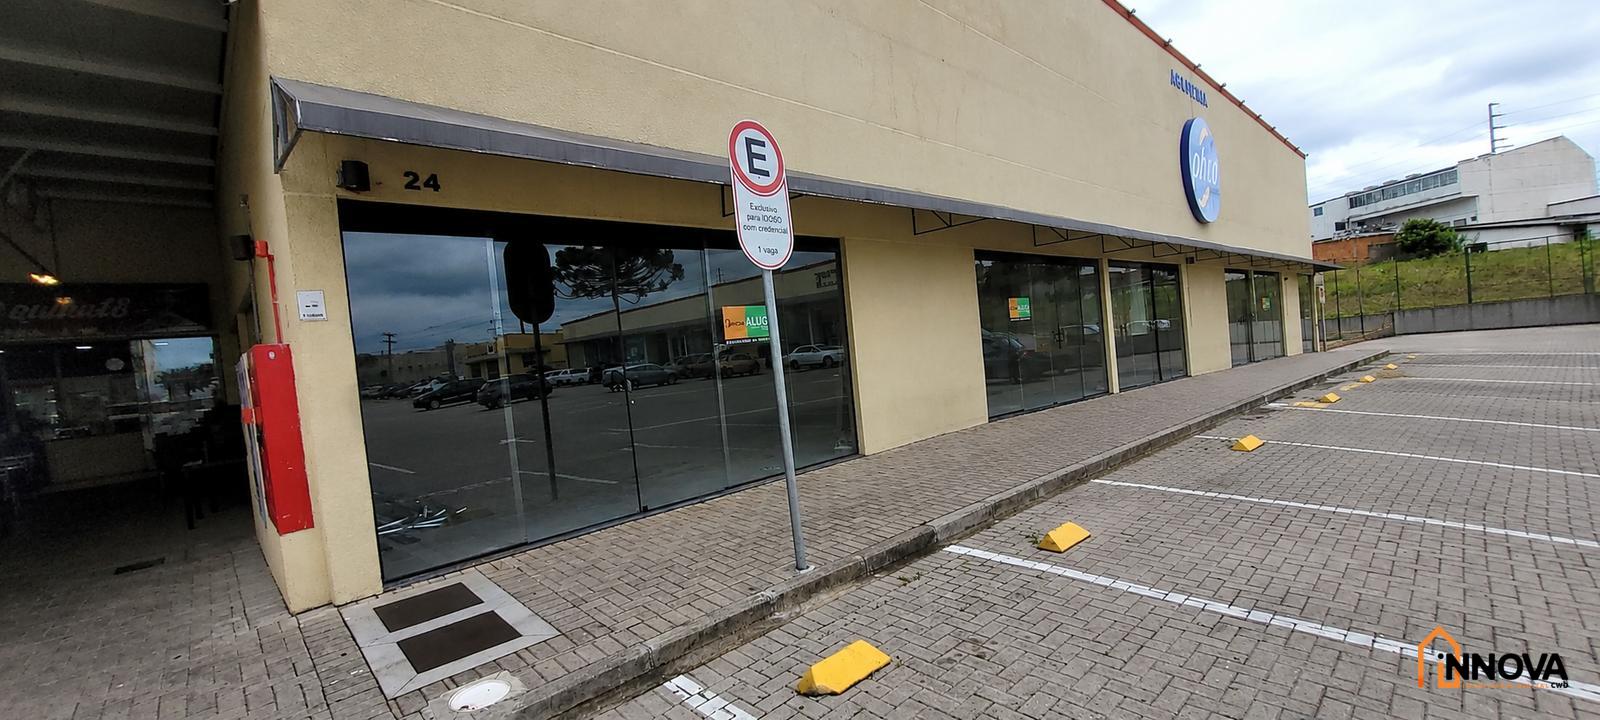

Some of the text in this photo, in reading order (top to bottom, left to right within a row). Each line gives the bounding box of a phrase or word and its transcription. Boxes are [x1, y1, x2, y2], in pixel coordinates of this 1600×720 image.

[745, 136, 770, 177] E
[403, 171, 441, 192] 24
[746, 214, 761, 222] para
[758, 225, 788, 234] credencial
[758, 245, 779, 256] 1 vaga
[746, 316, 768, 327] ALUG
